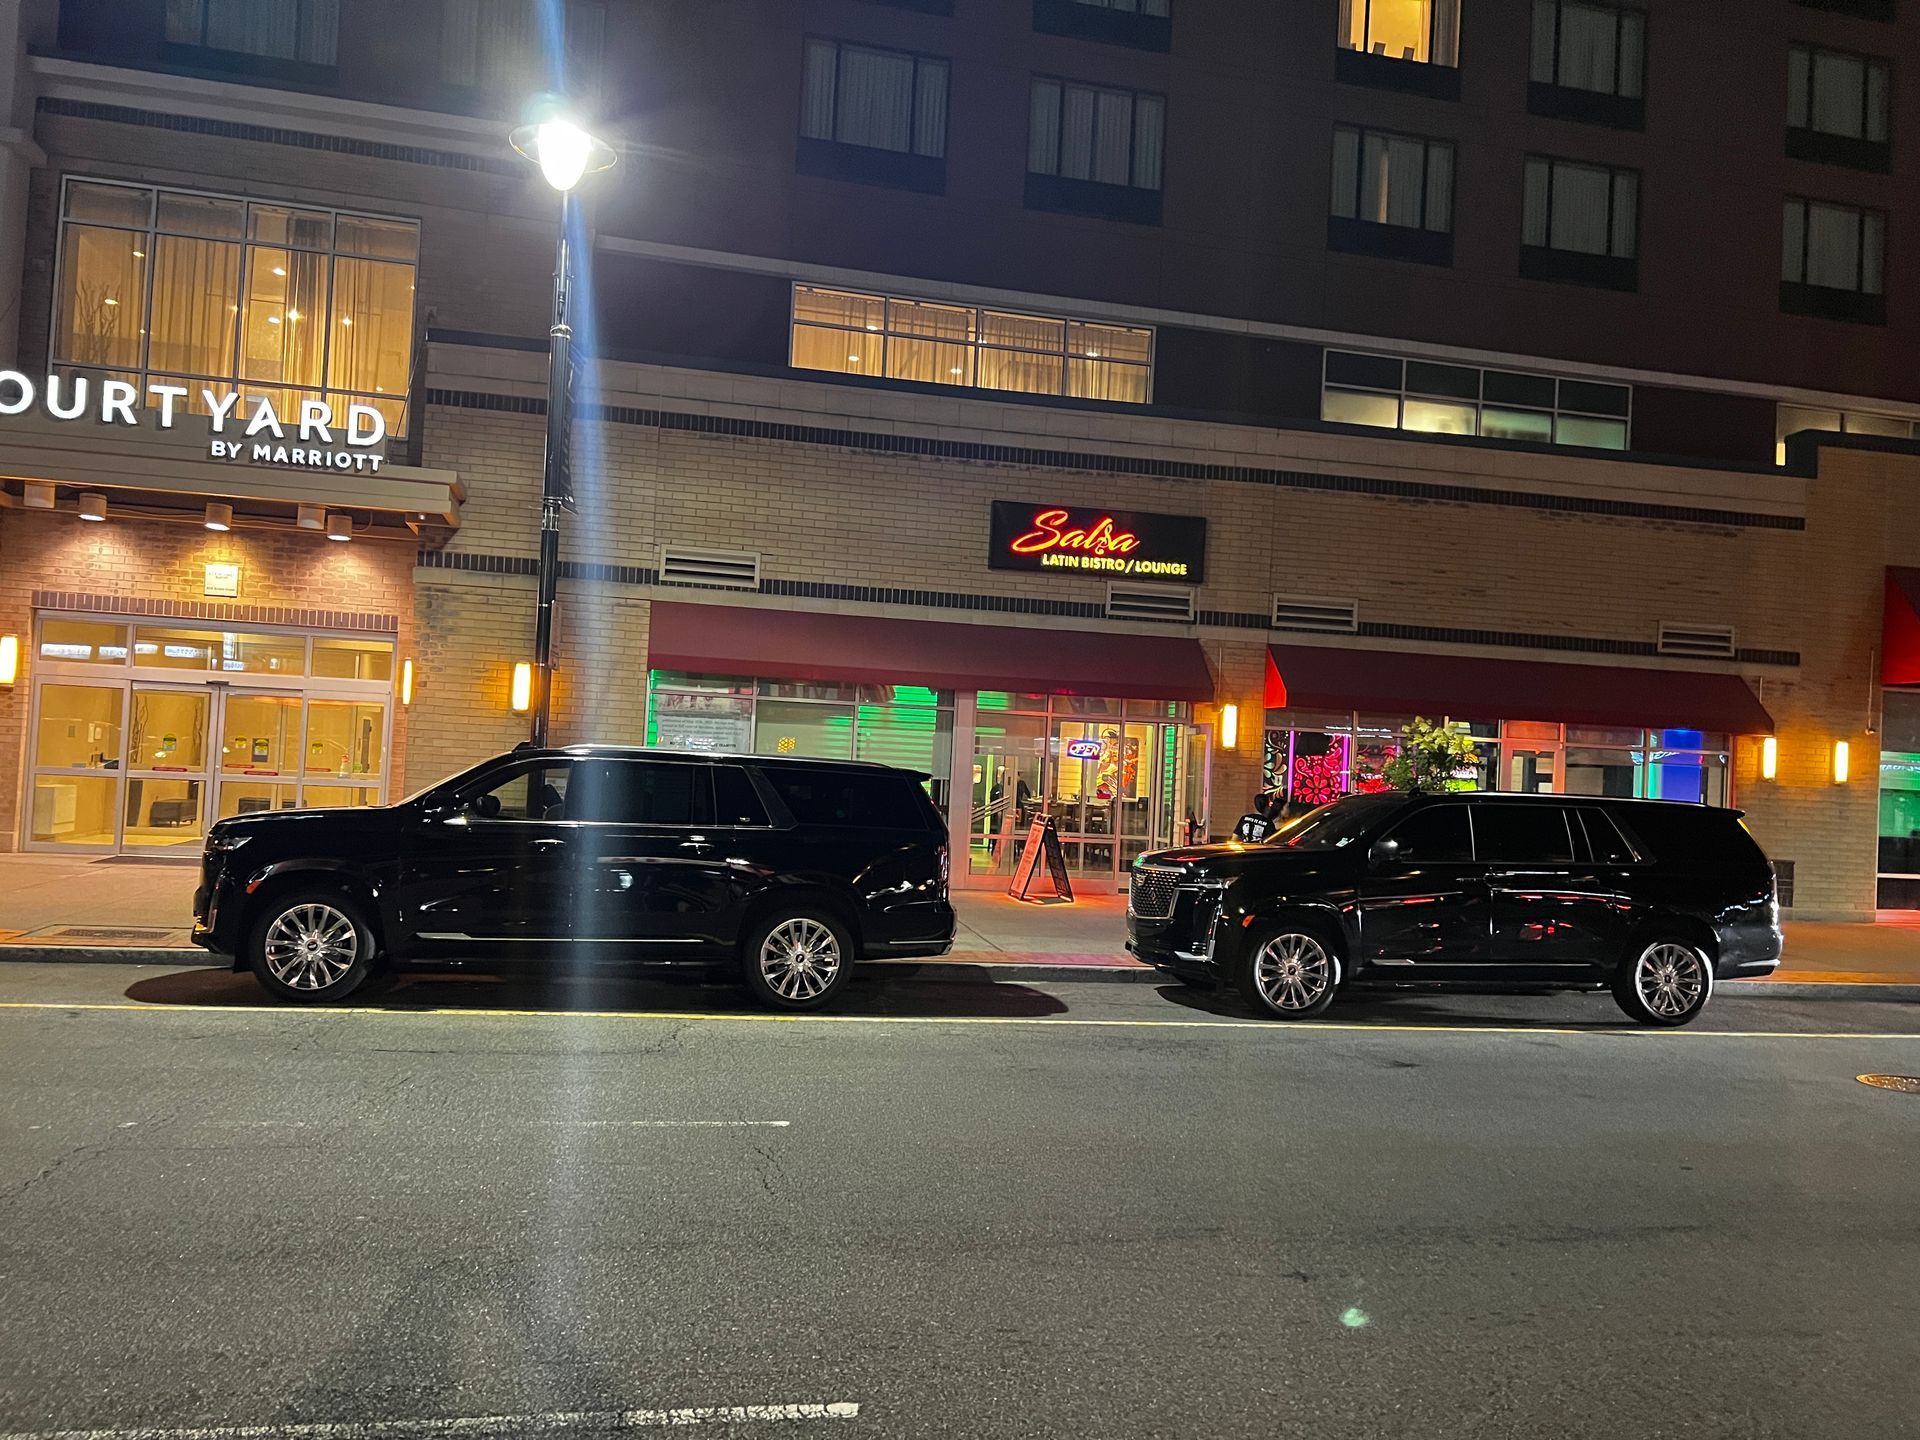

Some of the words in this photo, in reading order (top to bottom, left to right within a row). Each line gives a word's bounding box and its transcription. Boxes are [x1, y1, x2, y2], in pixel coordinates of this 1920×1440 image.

[0, 371, 386, 446] OURTYARD
[211, 440, 242, 459] BY
[253, 445, 383, 471] MARRIOTT
[1012, 510, 1140, 554] Salsa
[1042, 553, 1079, 568] LATIN
[1070, 743, 1099, 756] OPEN
